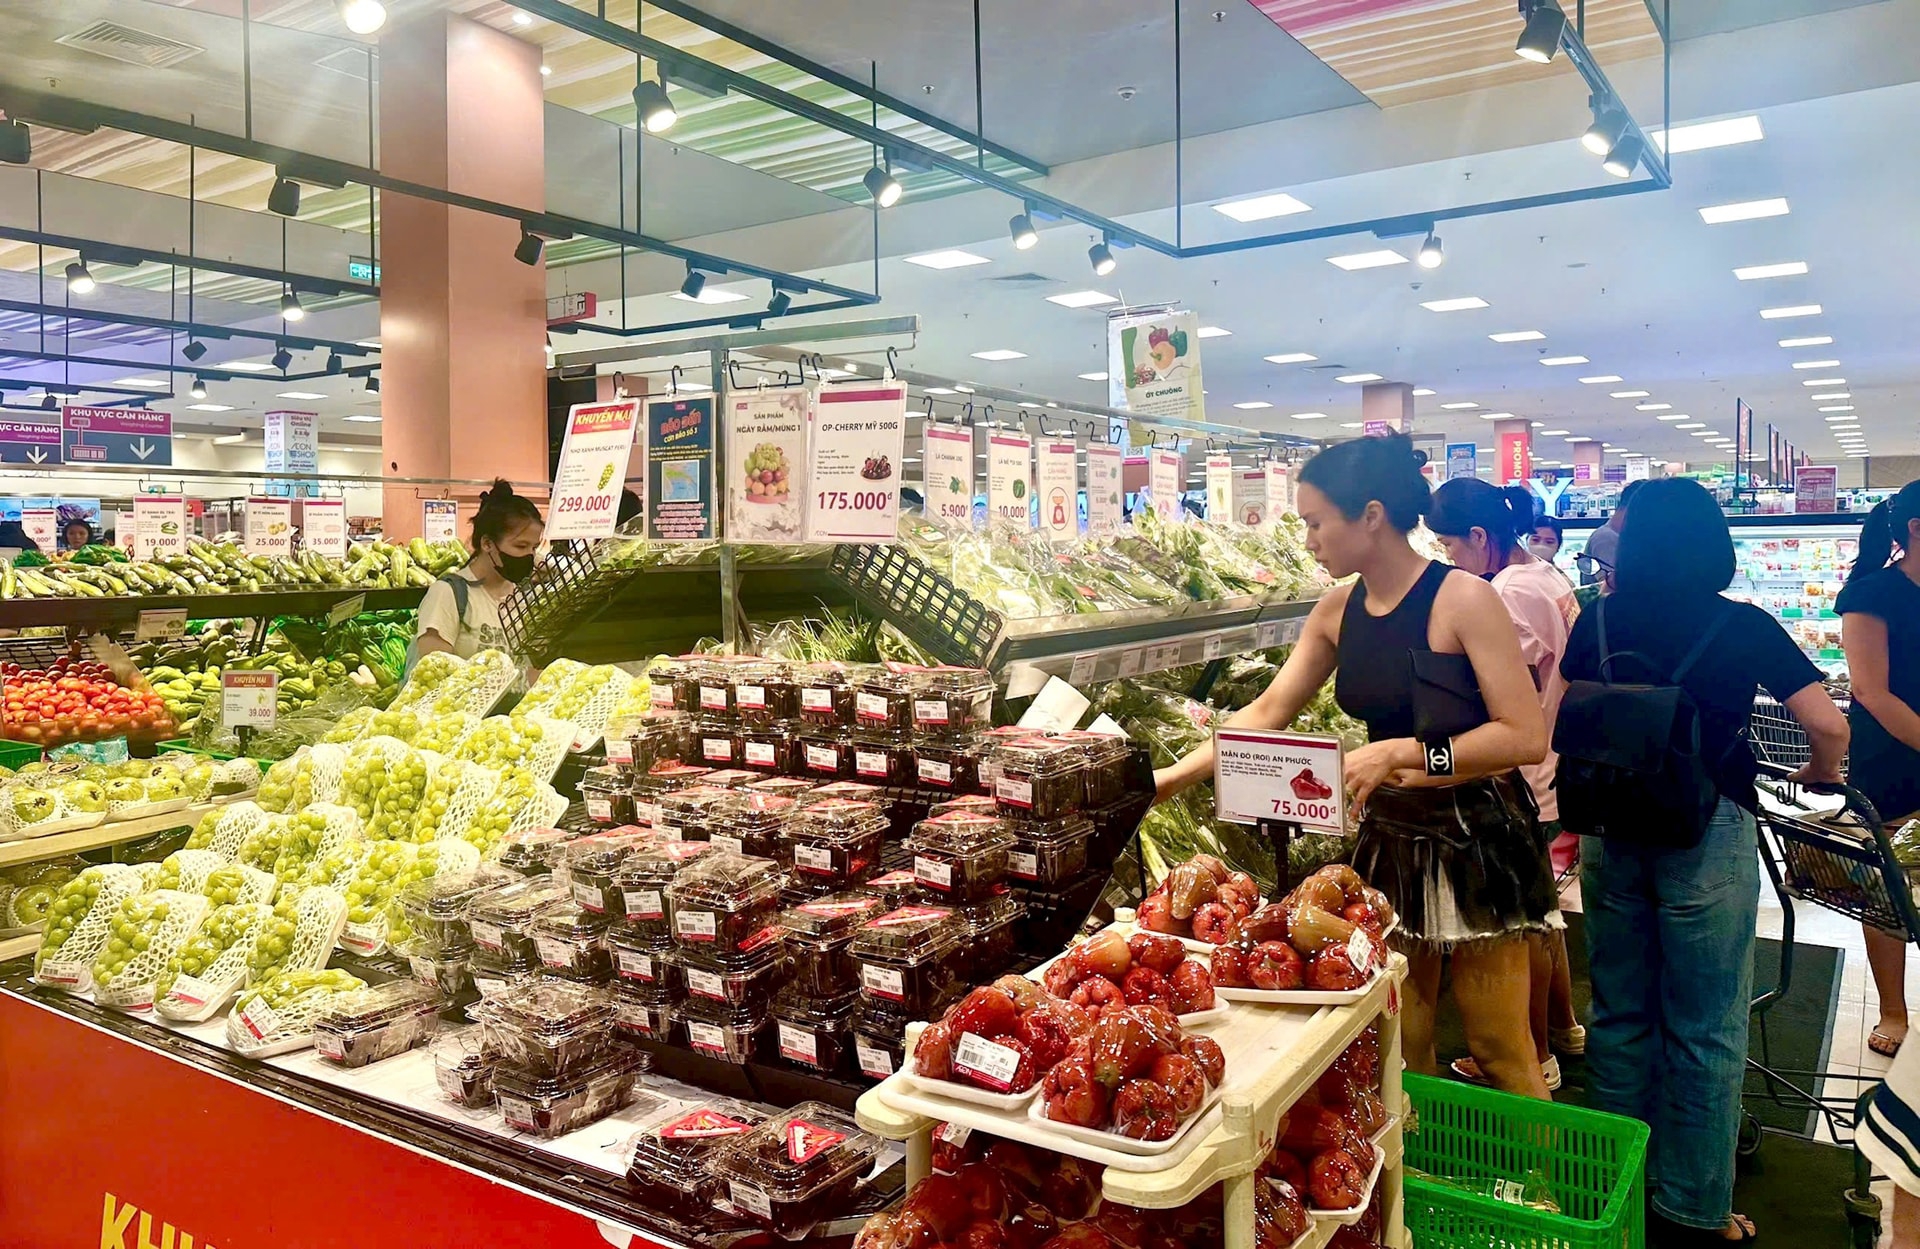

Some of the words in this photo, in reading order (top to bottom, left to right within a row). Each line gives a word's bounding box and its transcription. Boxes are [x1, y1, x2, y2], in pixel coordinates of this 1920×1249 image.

[1155, 386, 1183, 397] CHUÔNG
[71, 408, 91, 417] KHU
[93, 410, 114, 420] VỰC
[138, 412, 164, 422] HÀNG
[575, 407, 613, 425] KHUYẾN
[614, 408, 633, 425] MẠI
[0, 423, 11, 432] ỰC
[35, 425, 59, 433] HÀNG
[737, 424, 756, 433] NGÀY
[822, 422, 863, 432] OP-CHERRY
[865, 420, 878, 431] MỸ
[879, 421, 898, 430] 500G
[818, 491, 893, 511] 175.000đ
[1272, 755, 1283, 763] AN
[1285, 755, 1312, 766] PHƯỚC
[1271, 799, 1337, 819] 75.000đ
[100, 1191, 217, 1249] KH
